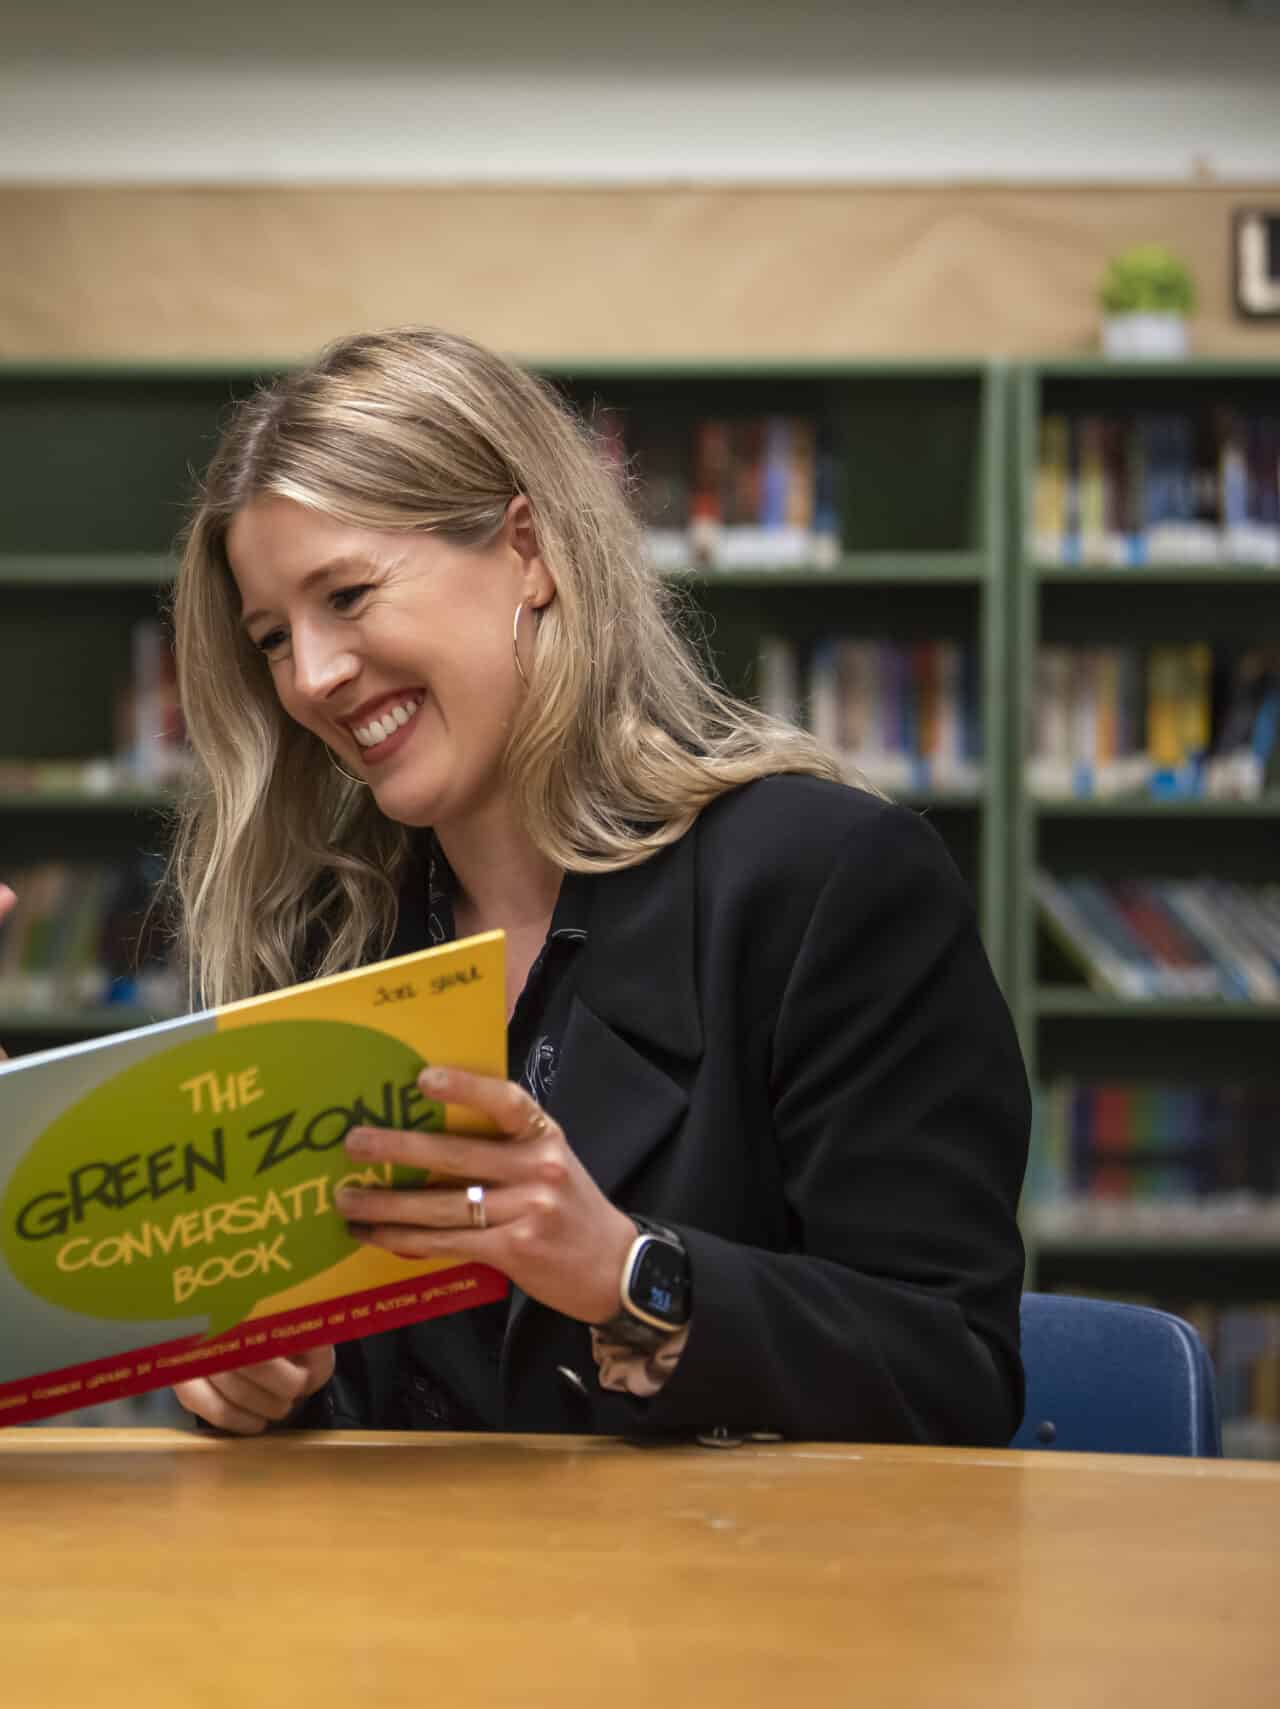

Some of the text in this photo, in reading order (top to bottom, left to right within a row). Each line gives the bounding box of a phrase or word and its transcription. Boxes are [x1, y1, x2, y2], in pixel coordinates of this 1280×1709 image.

[179, 1065, 265, 1114] THE
[15, 1081, 435, 1242] GREEN ZONE
[172, 1233, 292, 1304] BOOK
